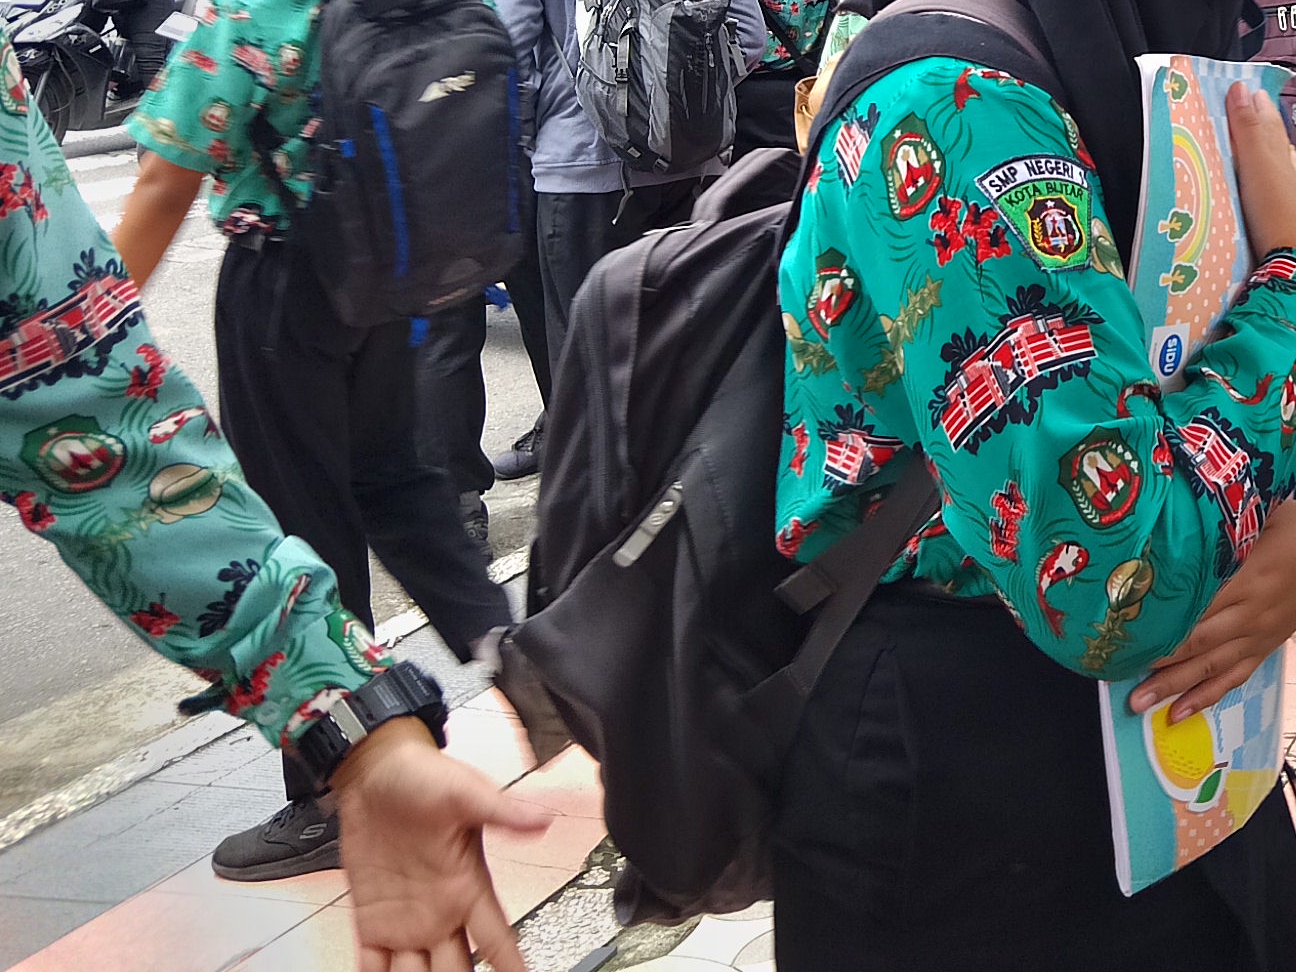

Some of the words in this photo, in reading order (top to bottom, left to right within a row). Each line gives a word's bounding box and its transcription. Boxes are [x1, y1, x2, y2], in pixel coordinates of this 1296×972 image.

[988, 165, 1019, 193] SMP
[1024, 159, 1074, 179] NEGERI
[1004, 183, 1042, 207] KOTA
[1045, 181, 1084, 202] BLITAR
